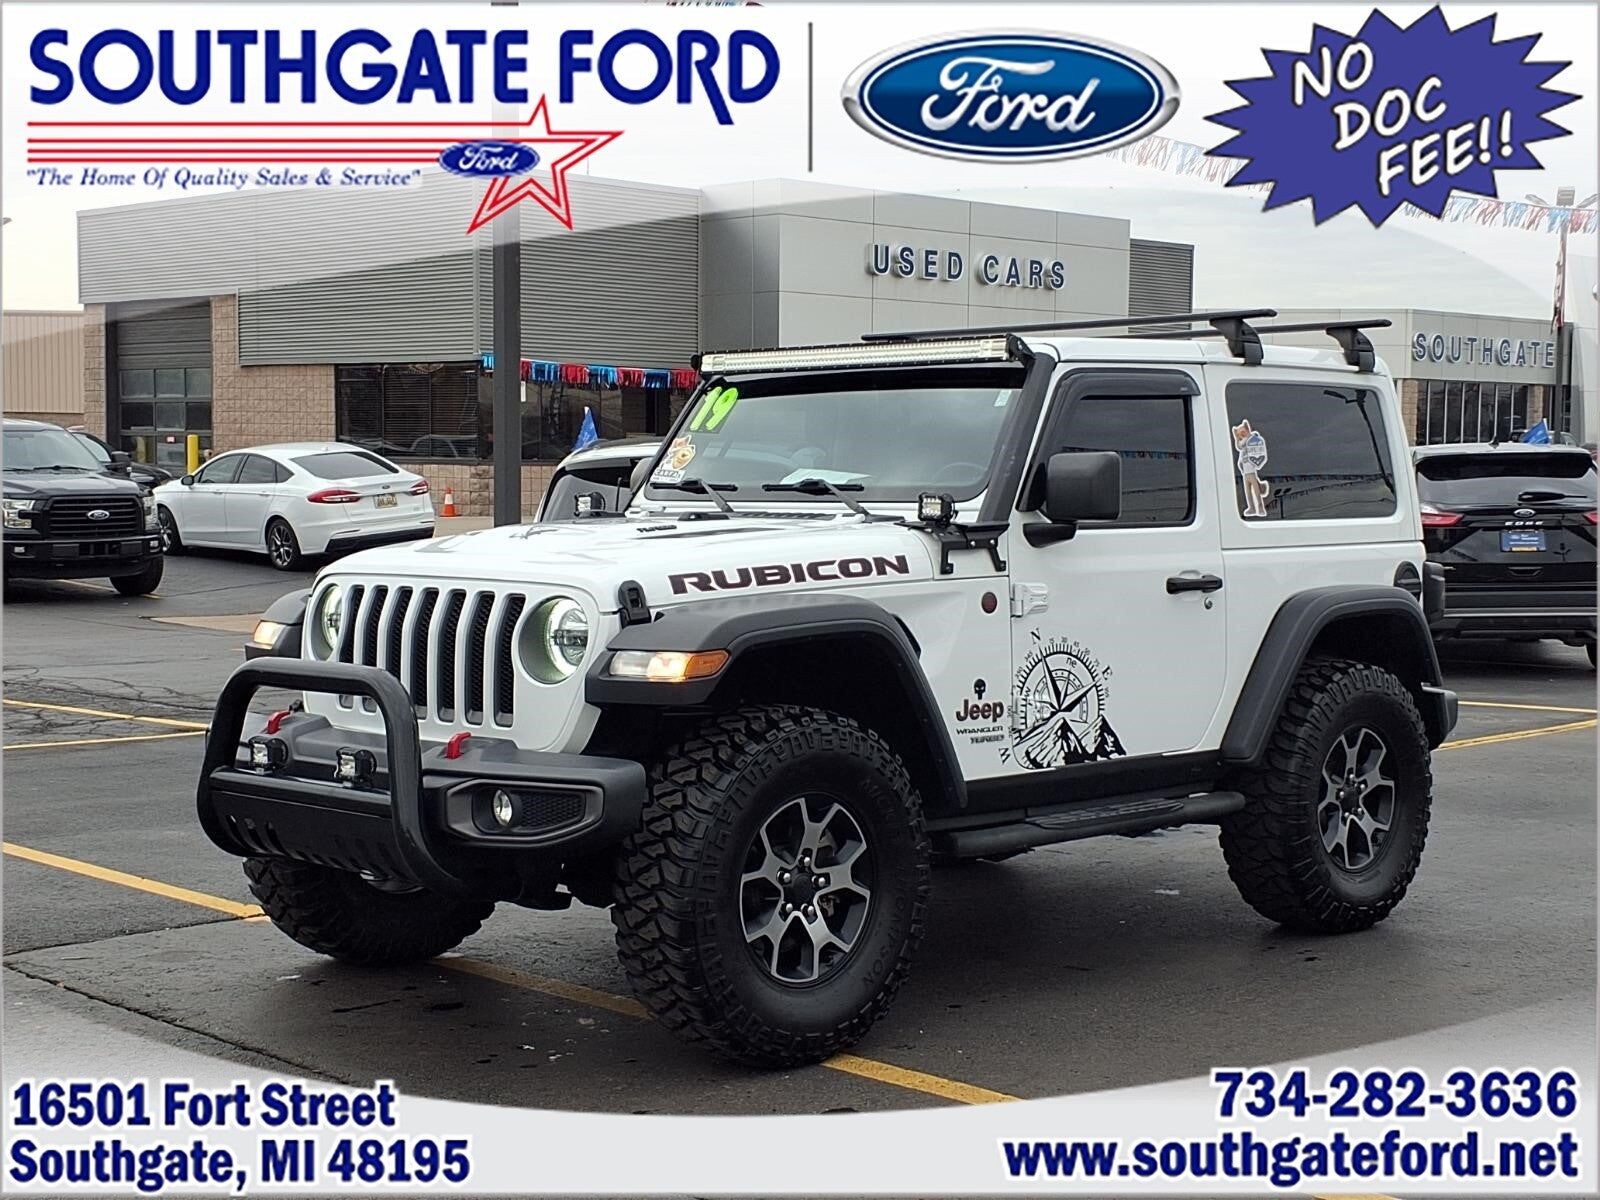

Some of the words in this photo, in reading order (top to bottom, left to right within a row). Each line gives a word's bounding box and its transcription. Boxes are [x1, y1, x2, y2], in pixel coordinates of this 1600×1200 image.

[871, 243, 964, 281] USED
[981, 254, 1066, 290] CARS
[1413, 331, 1555, 369] SOUTHGATE
[690, 386, 739, 431] 19
[668, 554, 911, 595] RUBICON
[956, 698, 1004, 723] Jeep
[956, 725, 1004, 736] WRANGLER
